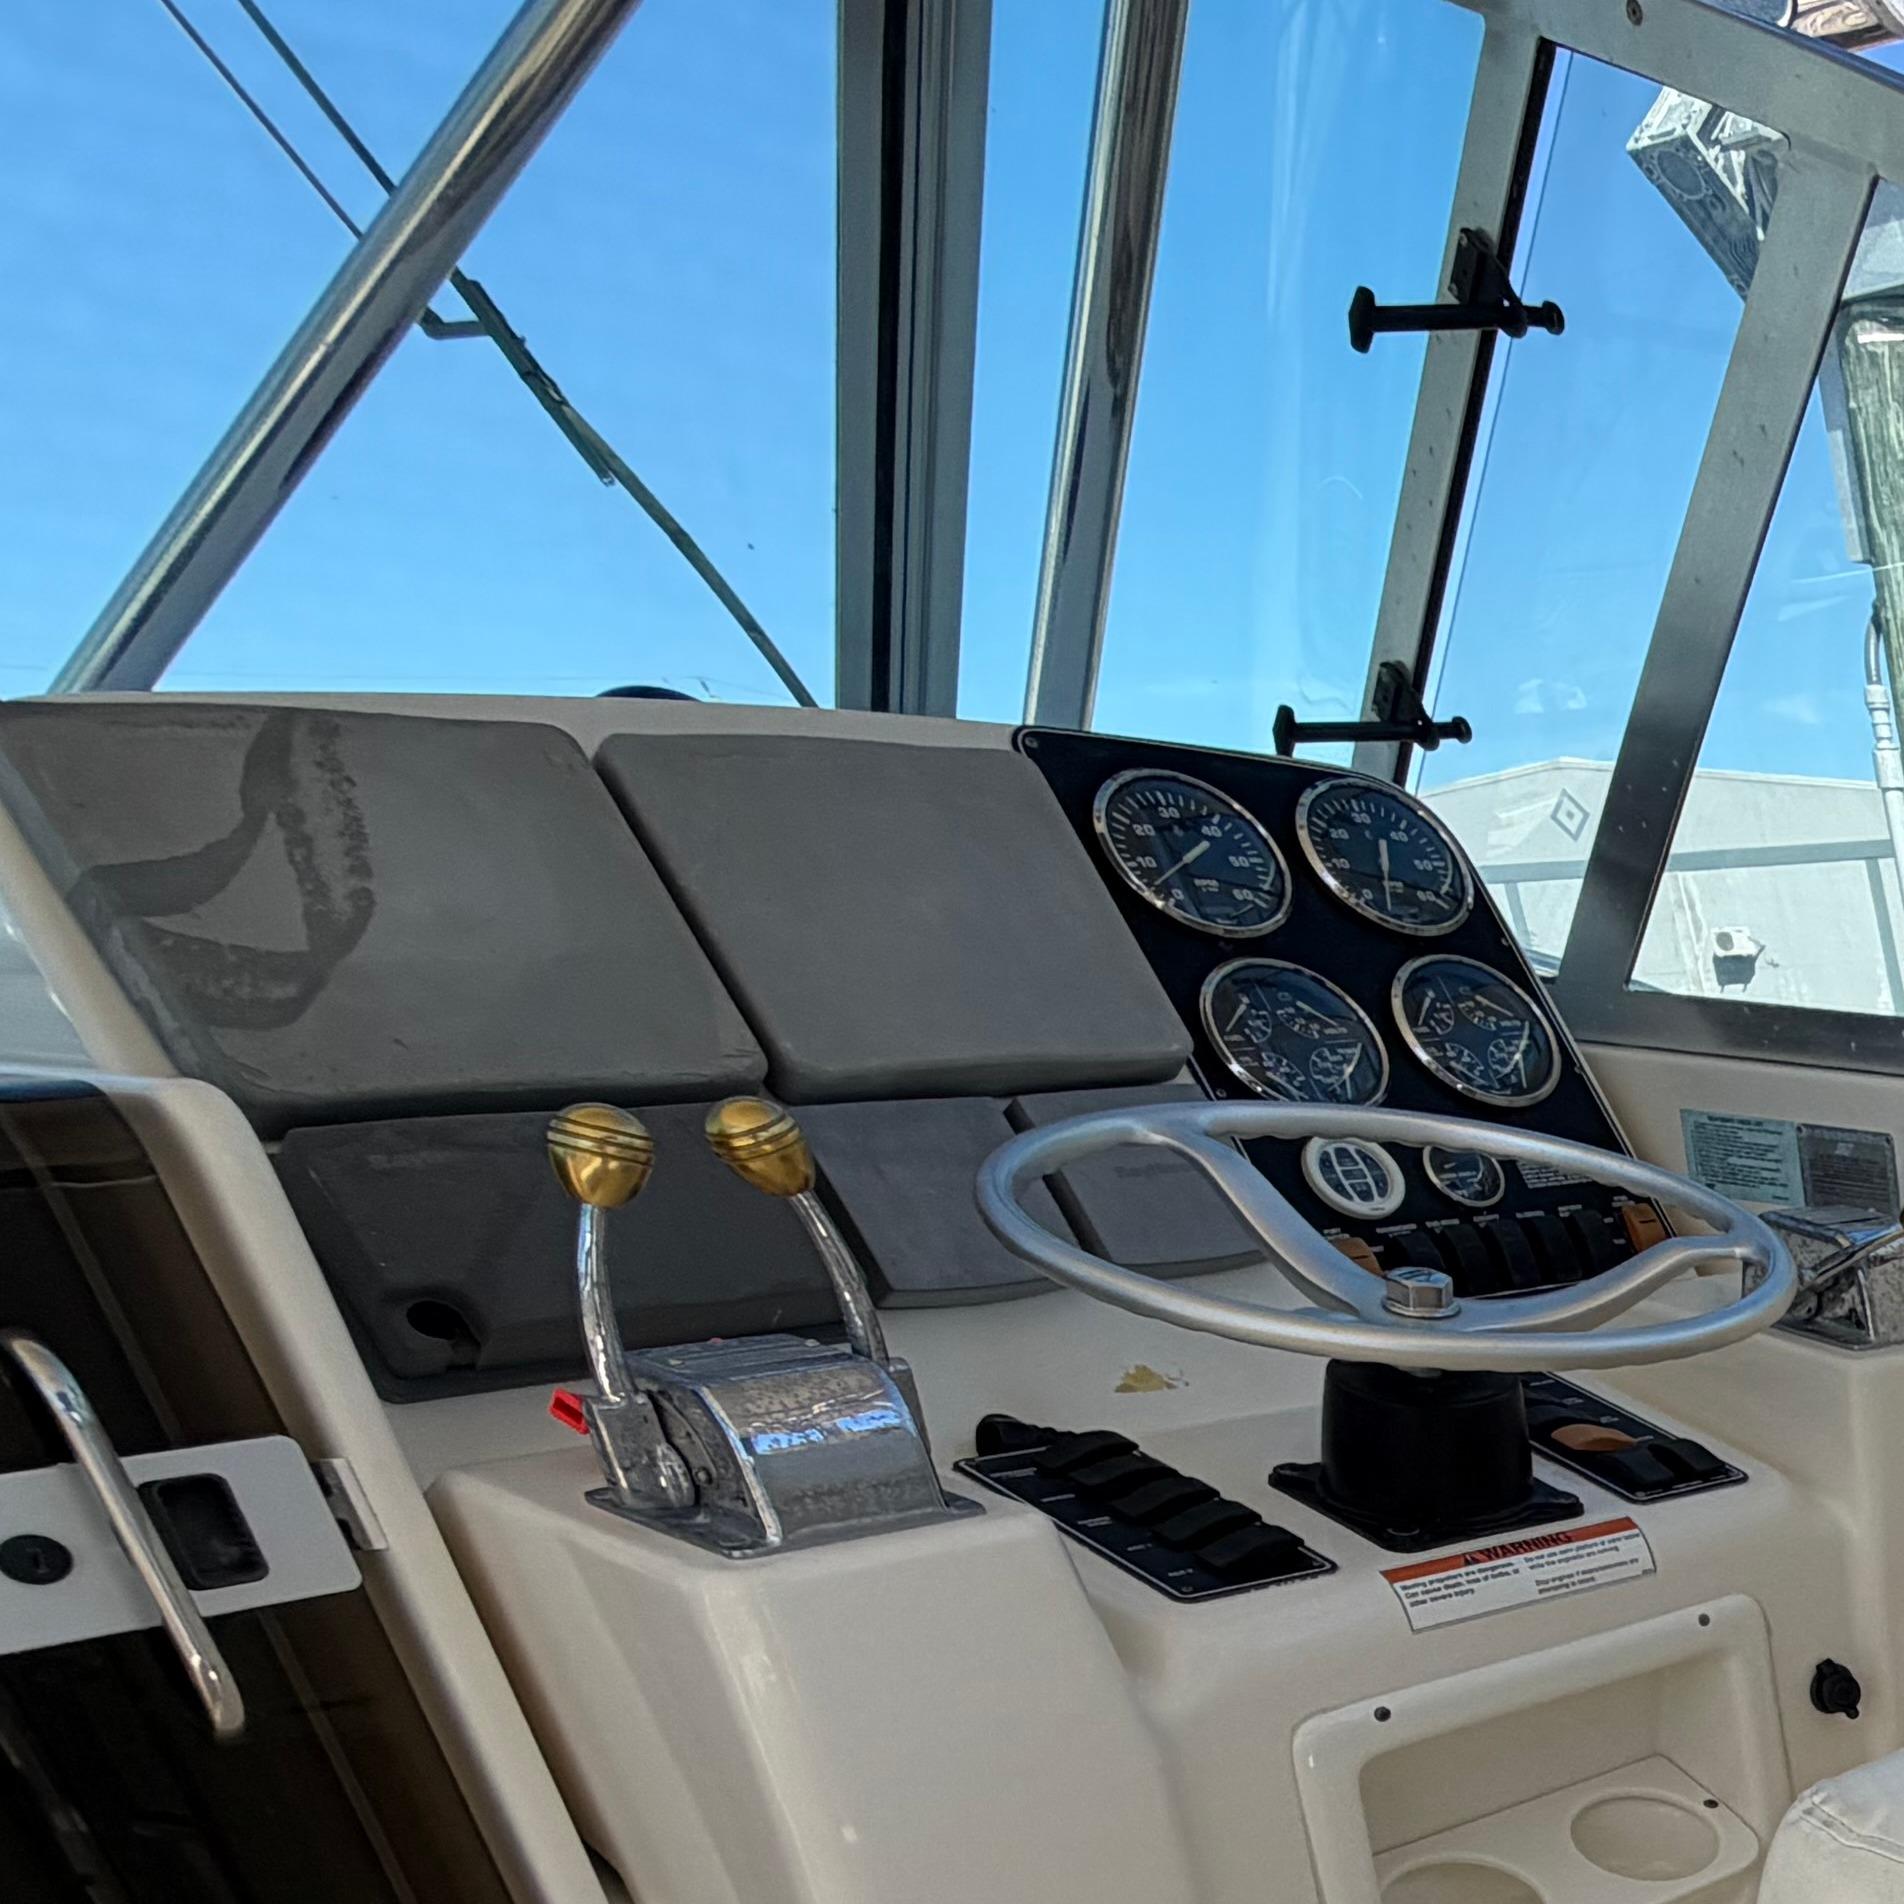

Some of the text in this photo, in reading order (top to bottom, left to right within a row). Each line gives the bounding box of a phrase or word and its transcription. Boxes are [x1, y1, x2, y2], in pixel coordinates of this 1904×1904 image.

[1157, 806, 1180, 818] 30
[1350, 812, 1371, 824] 30
[1132, 823, 1156, 836] 20
[1200, 825, 1223, 837] 40
[1328, 828, 1349, 839] 20
[1389, 831, 1408, 842] 40
[1135, 855, 1158, 868] 10
[1227, 855, 1251, 867] 50
[1331, 857, 1350, 869] 10
[1231, 889, 1254, 900] 60
[1477, 1531, 1573, 1561] WARNING
